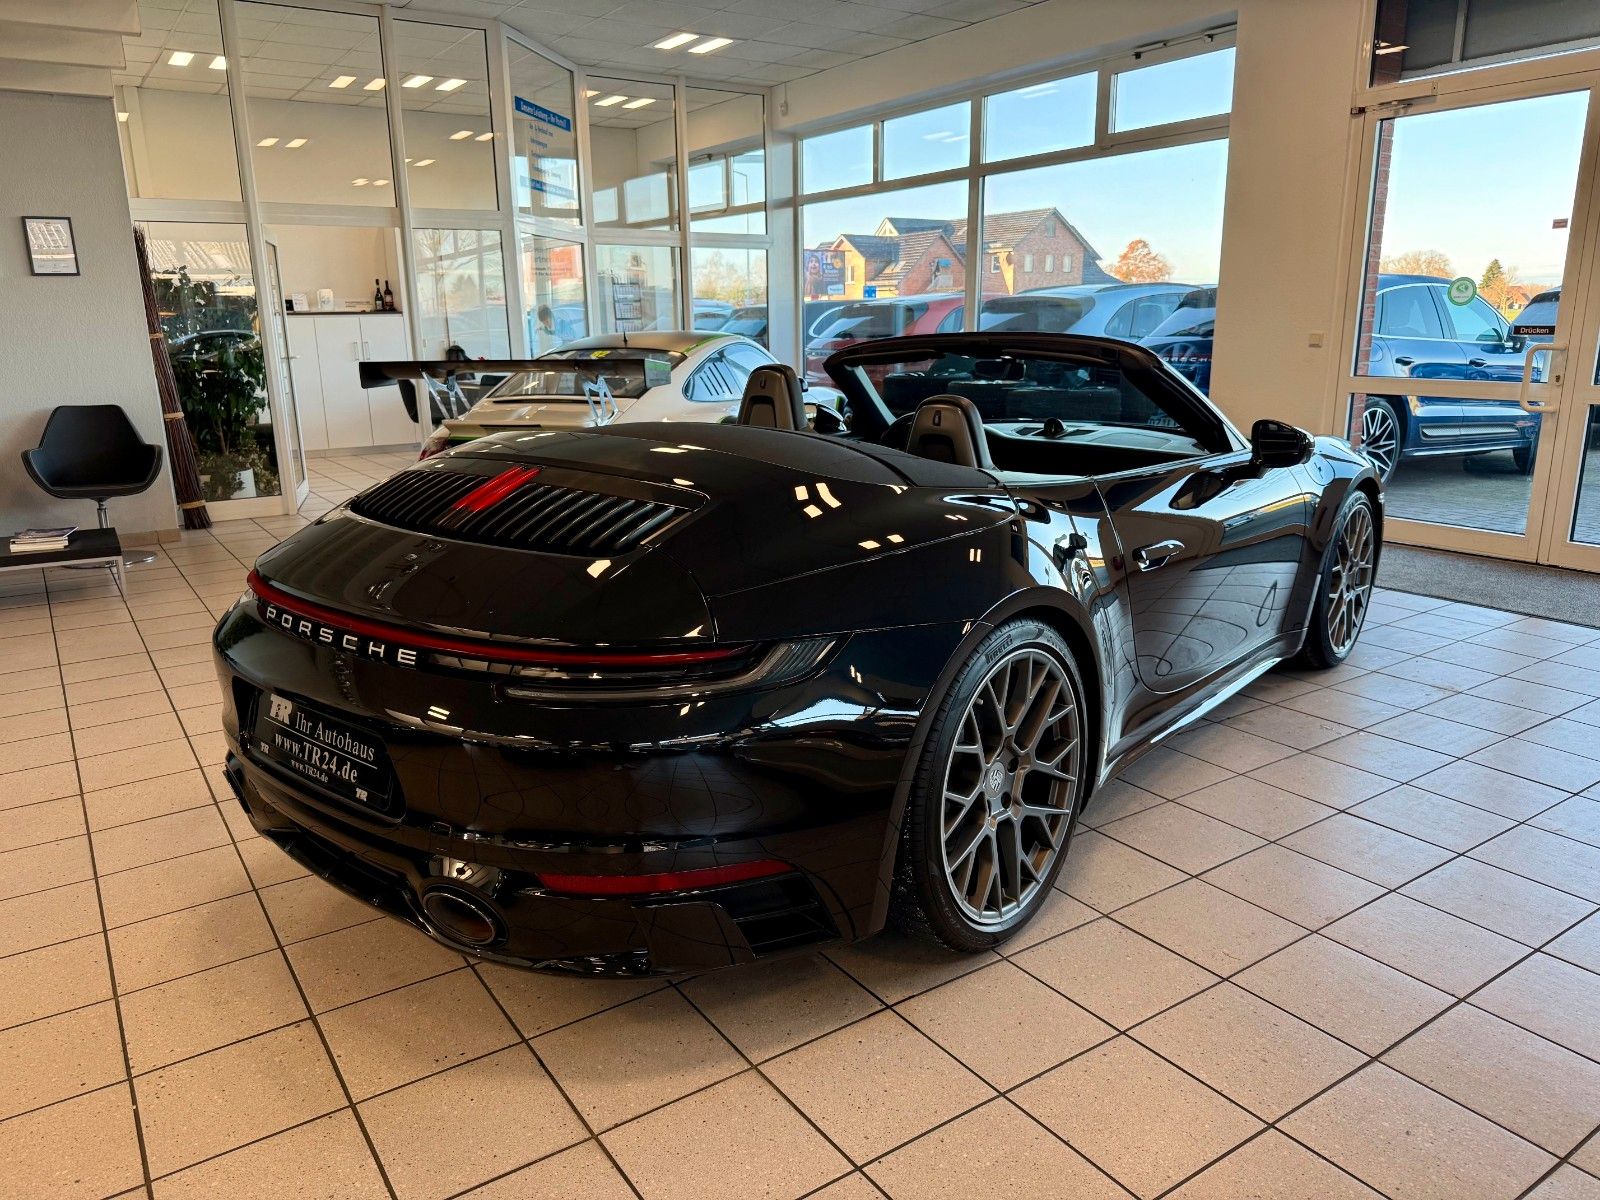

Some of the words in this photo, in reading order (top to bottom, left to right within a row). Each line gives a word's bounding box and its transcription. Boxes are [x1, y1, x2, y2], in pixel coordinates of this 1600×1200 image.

[1520, 326, 1549, 335] Drücken
[266, 606, 417, 665] PORSCHE
[275, 733, 358, 783] www.TR24.de
[295, 711, 313, 734] Ihr
[314, 721, 375, 762] Autohaus
[291, 759, 329, 783] www.TR24.de
